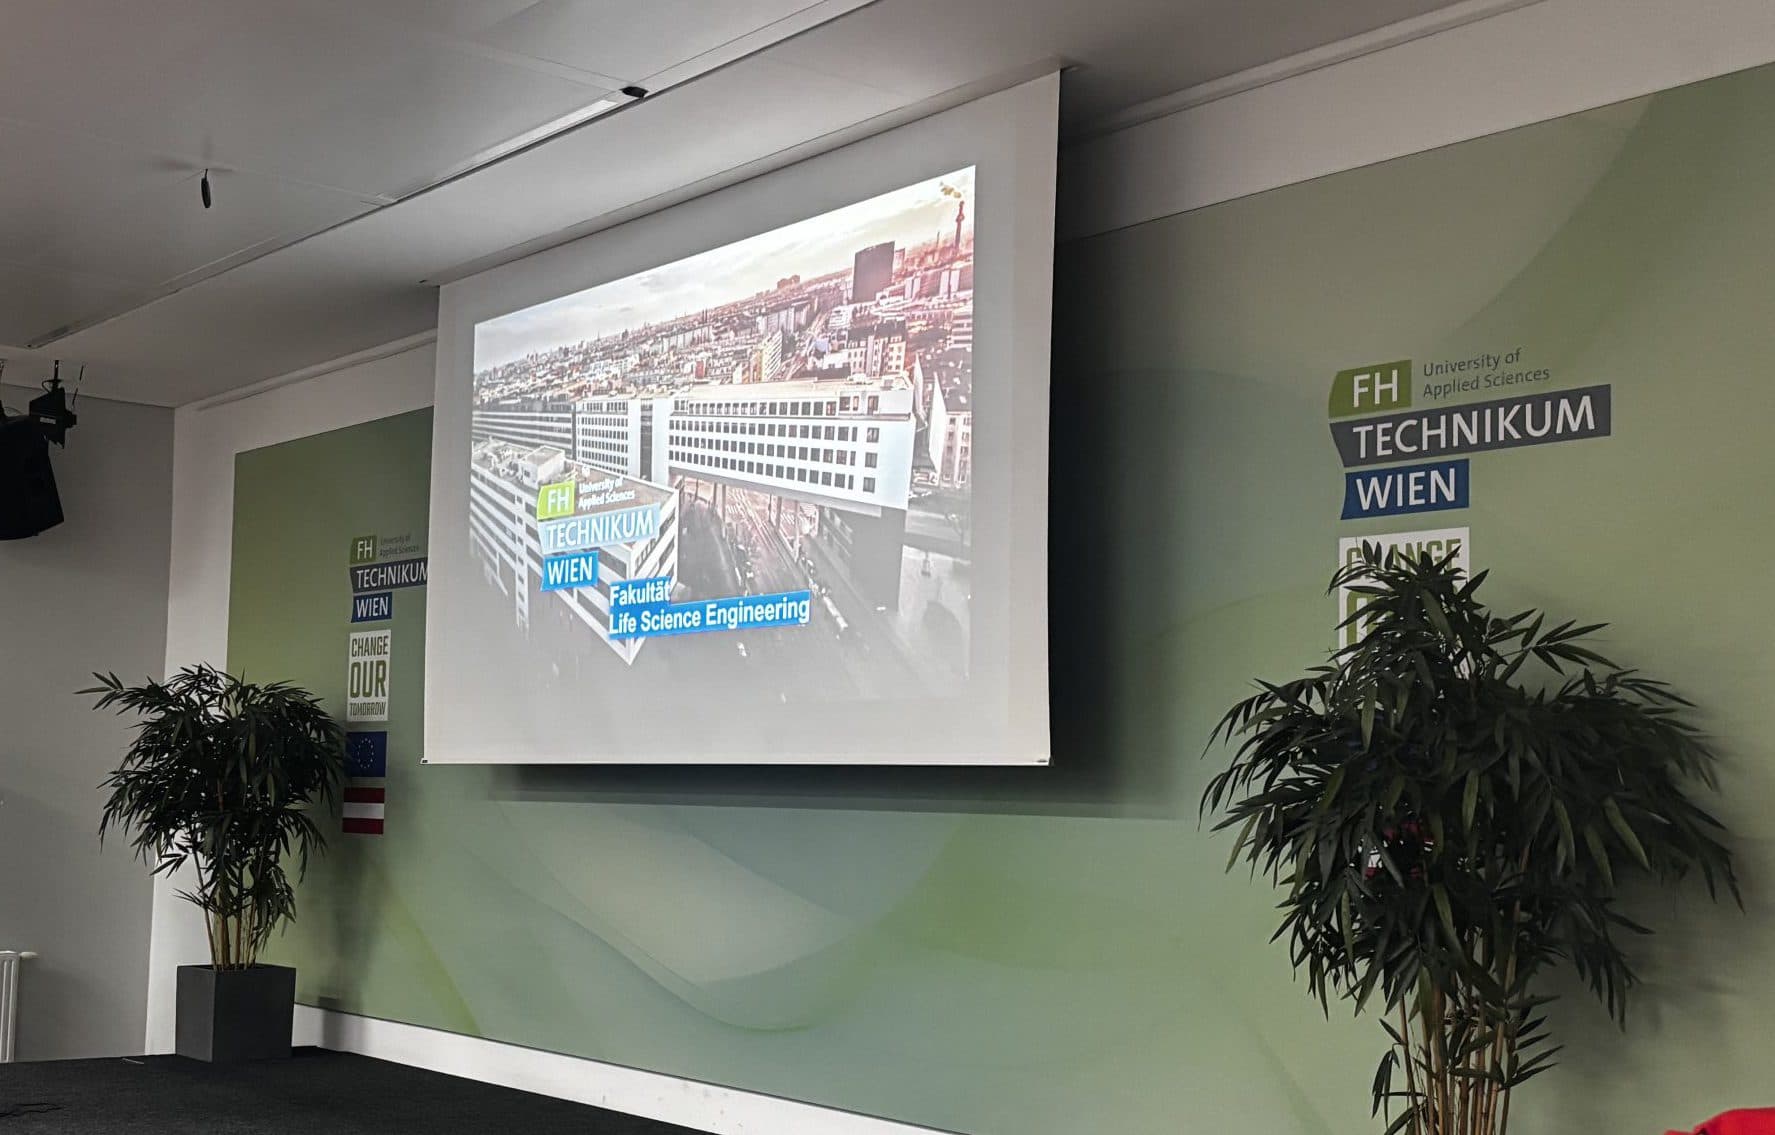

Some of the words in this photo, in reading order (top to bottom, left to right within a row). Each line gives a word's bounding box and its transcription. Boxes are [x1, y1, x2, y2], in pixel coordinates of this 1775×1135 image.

[1423, 354, 1500, 377] University
[1505, 347, 1521, 364] of
[1353, 369, 1399, 408] FH
[1423, 376, 1479, 399] Applied
[1484, 369, 1550, 389] Sciences
[1352, 395, 1596, 459] TECHNIKUM
[547, 486, 571, 513] FH
[578, 492, 605, 511] Applied
[605, 490, 635, 504] Sciences
[579, 478, 614, 494] University
[1355, 467, 1456, 511] WIEN
[547, 509, 654, 549] TECHNIKUM
[357, 540, 373, 560] FH
[547, 556, 592, 585] WIEN
[356, 596, 388, 618] WIEN
[610, 580, 672, 606] Fakultät
[610, 613, 637, 634] Life
[640, 609, 701, 632] Science
[706, 596, 810, 629] Engineering
[351, 635, 388, 657] CHANGE
[350, 660, 386, 698] OUR
[349, 701, 386, 716] TOMORROW
